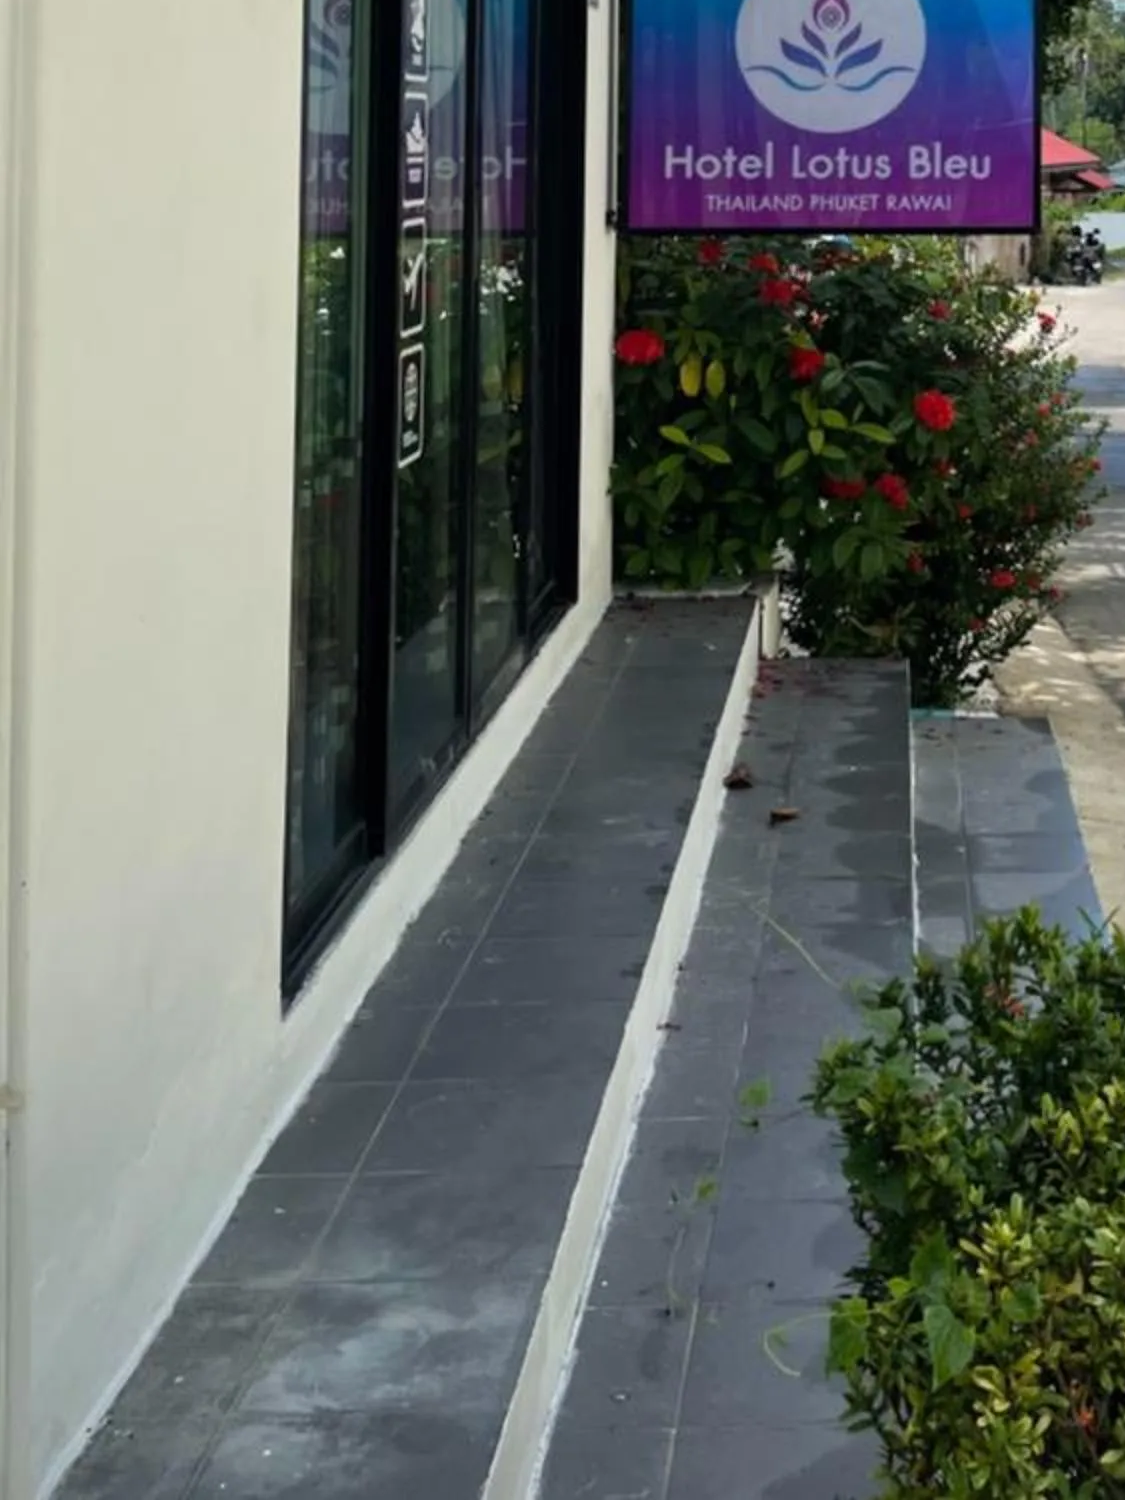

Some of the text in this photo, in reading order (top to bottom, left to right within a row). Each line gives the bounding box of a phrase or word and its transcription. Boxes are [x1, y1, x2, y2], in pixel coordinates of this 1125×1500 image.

[664, 141, 991, 180] Hotel Lotus Bleu
[706, 193, 951, 212] THAILAND PHUKET RAWAI
